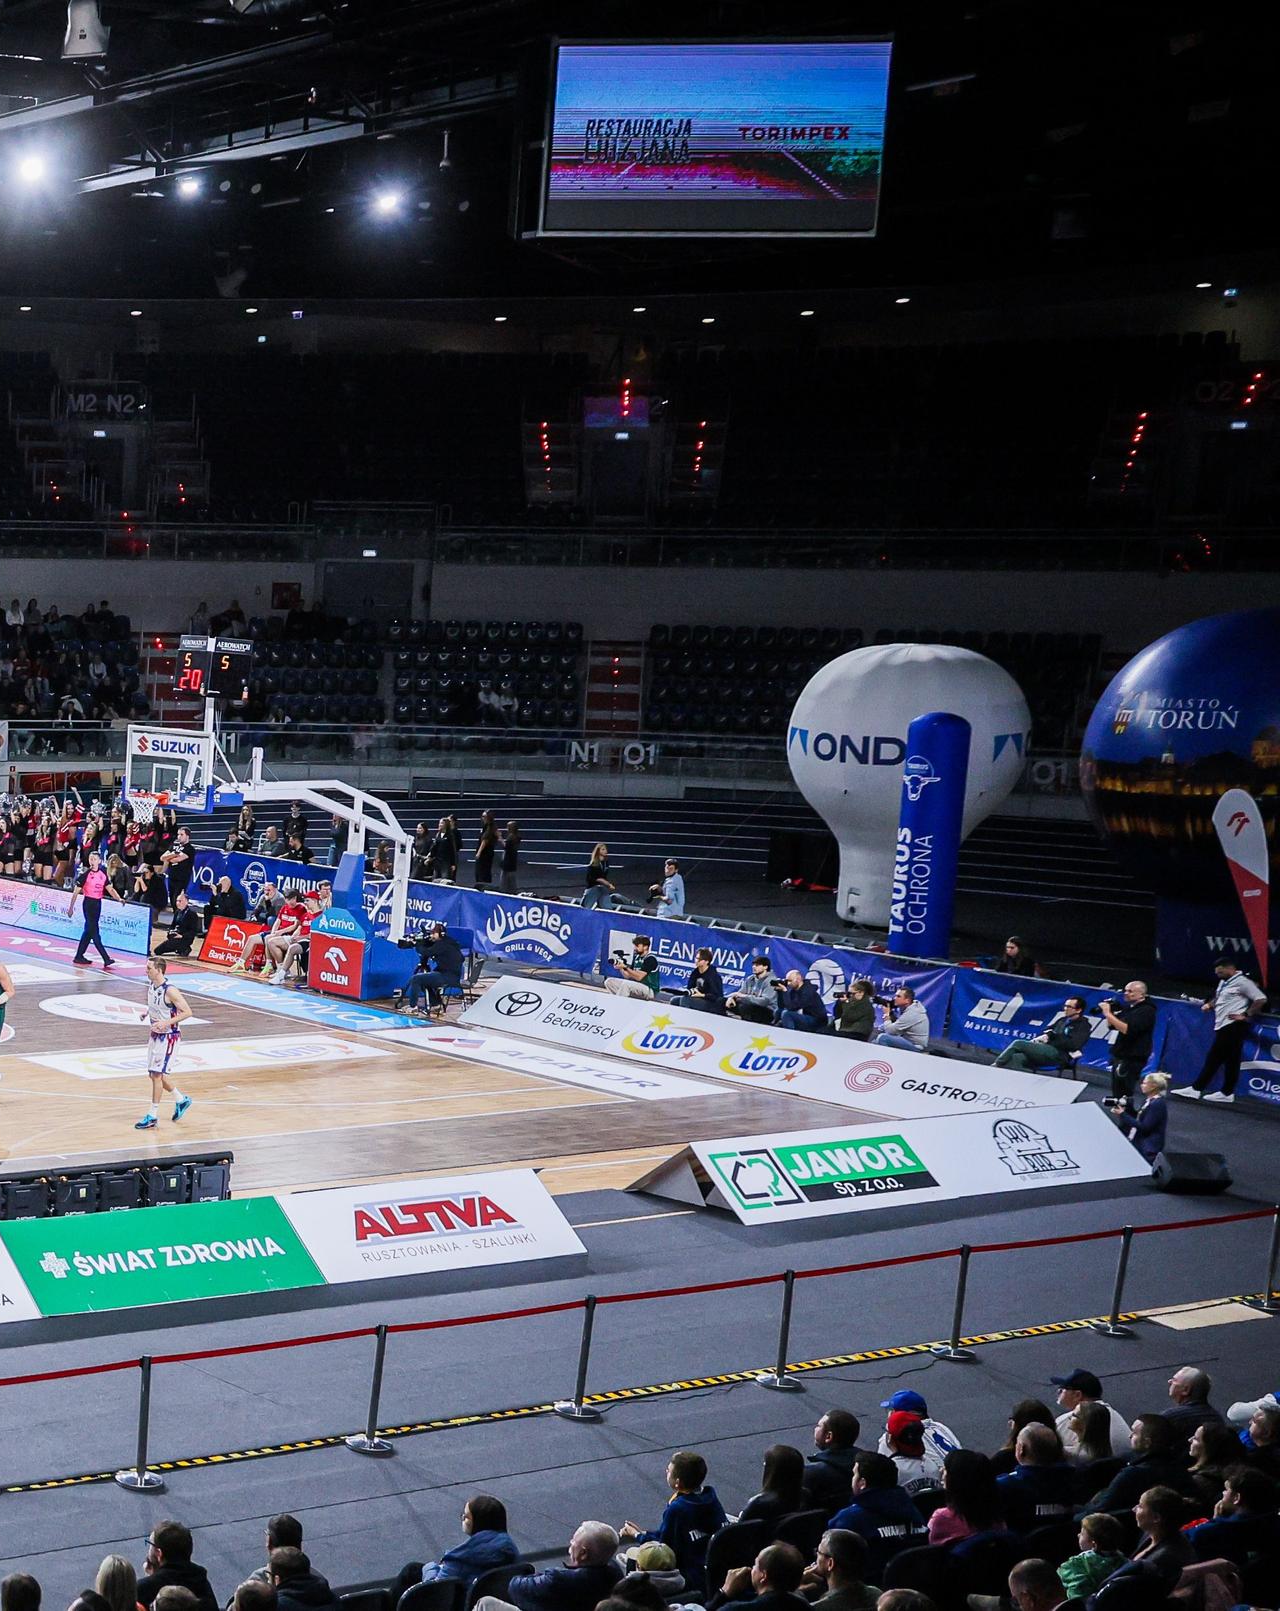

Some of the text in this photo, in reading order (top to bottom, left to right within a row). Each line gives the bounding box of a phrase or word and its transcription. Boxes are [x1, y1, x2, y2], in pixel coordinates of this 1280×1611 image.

[586, 119, 850, 140] RESTAURACJA TORIMPEX
[216, 641, 251, 650] AEROWATCH
[184, 653, 192, 667] 5
[221, 655, 230, 669] 5
[179, 669, 203, 690] 20
[1147, 704, 1239, 729] TORUŃ
[151, 739, 200, 755] SUZUKI
[889, 828, 911, 935] TAURUS
[907, 834, 934, 935] OCHRONA
[328, 919, 355, 931] arriva
[505, 943, 525, 954] GRILL
[709, 944, 749, 969] WAY
[319, 971, 348, 986] ORLEN
[557, 998, 607, 1018] Toyota
[542, 1011, 620, 1040] Bednarscy
[964, 1020, 1011, 1036] Mariusz
[640, 1030, 698, 1050] LOTTO
[490, 1048, 664, 1089] APATOR
[738, 1050, 800, 1071] LOTTO
[901, 1079, 1037, 1109] GASTROPARTS
[782, 1143, 917, 1180] JAWOR
[354, 1194, 519, 1242] ALTIVA
[73, 1235, 286, 1277] ŚWIAT ZDROWIA
[361, 1232, 538, 1264] RUSZTOWANIA SZALUNKI
